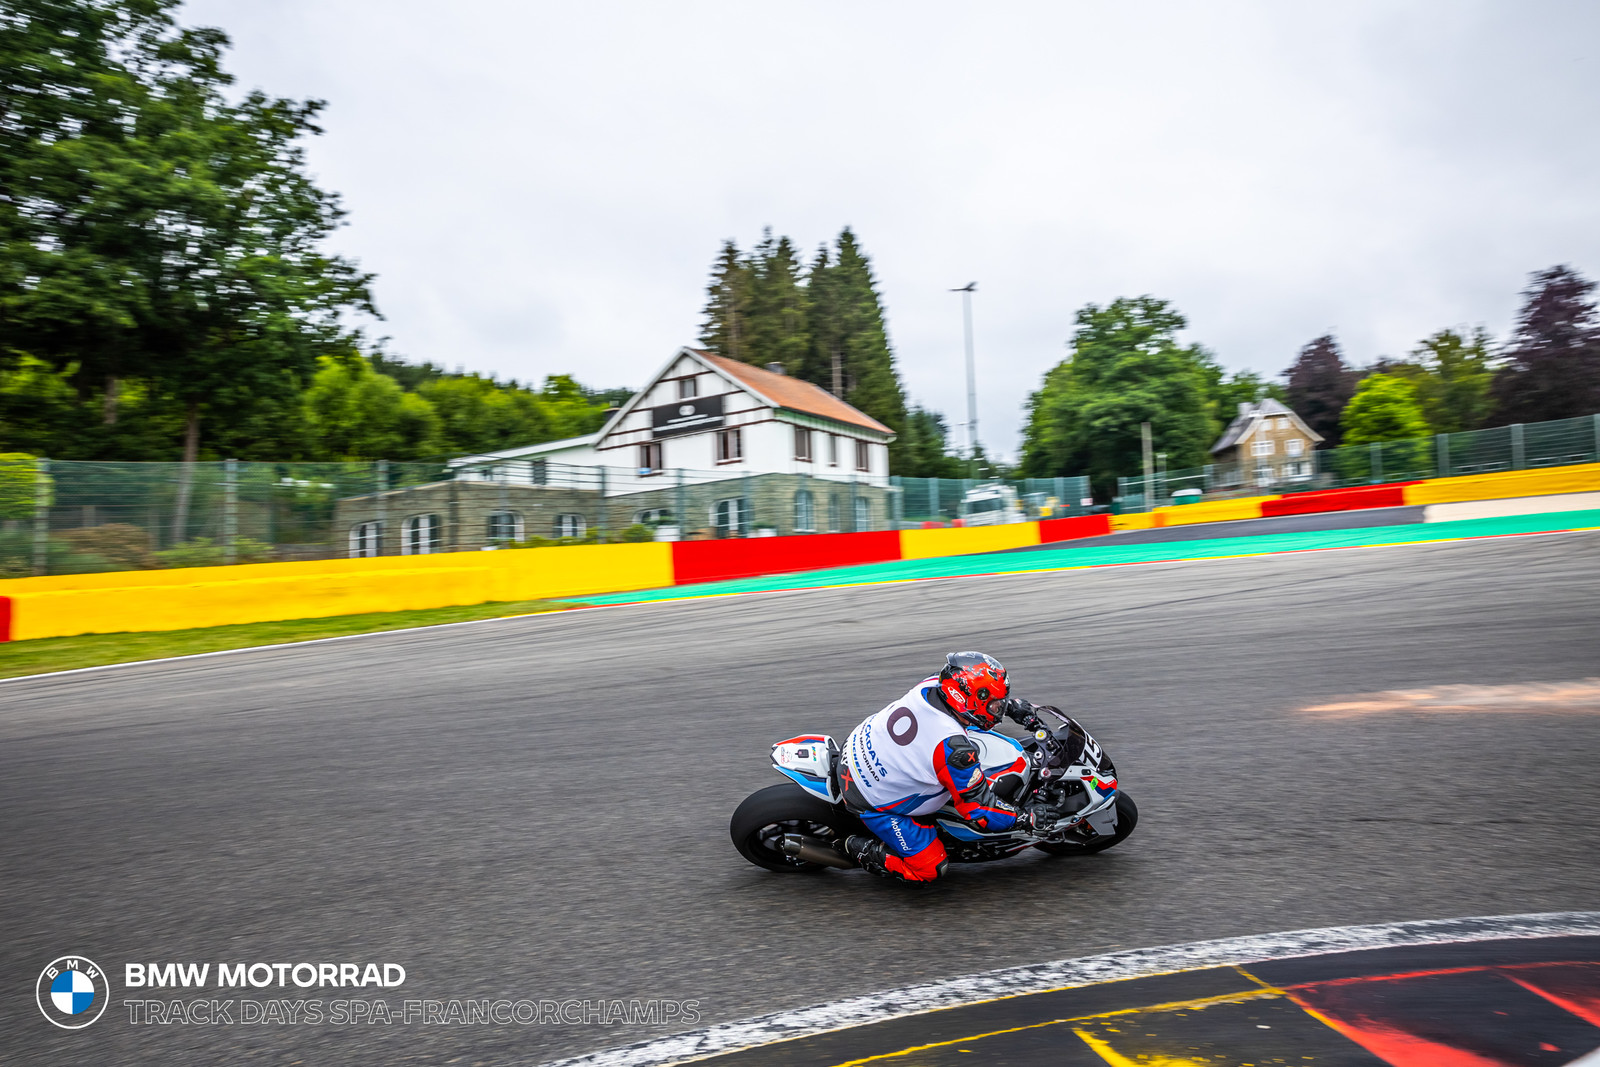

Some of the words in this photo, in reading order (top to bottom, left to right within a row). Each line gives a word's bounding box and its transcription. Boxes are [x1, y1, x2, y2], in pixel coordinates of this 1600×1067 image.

[853, 734, 872, 787] MICHELIN
[860, 737, 880, 782] MOTORRAD
[865, 715, 888, 777] CKDAYS
[890, 817, 912, 851] Motorrad
